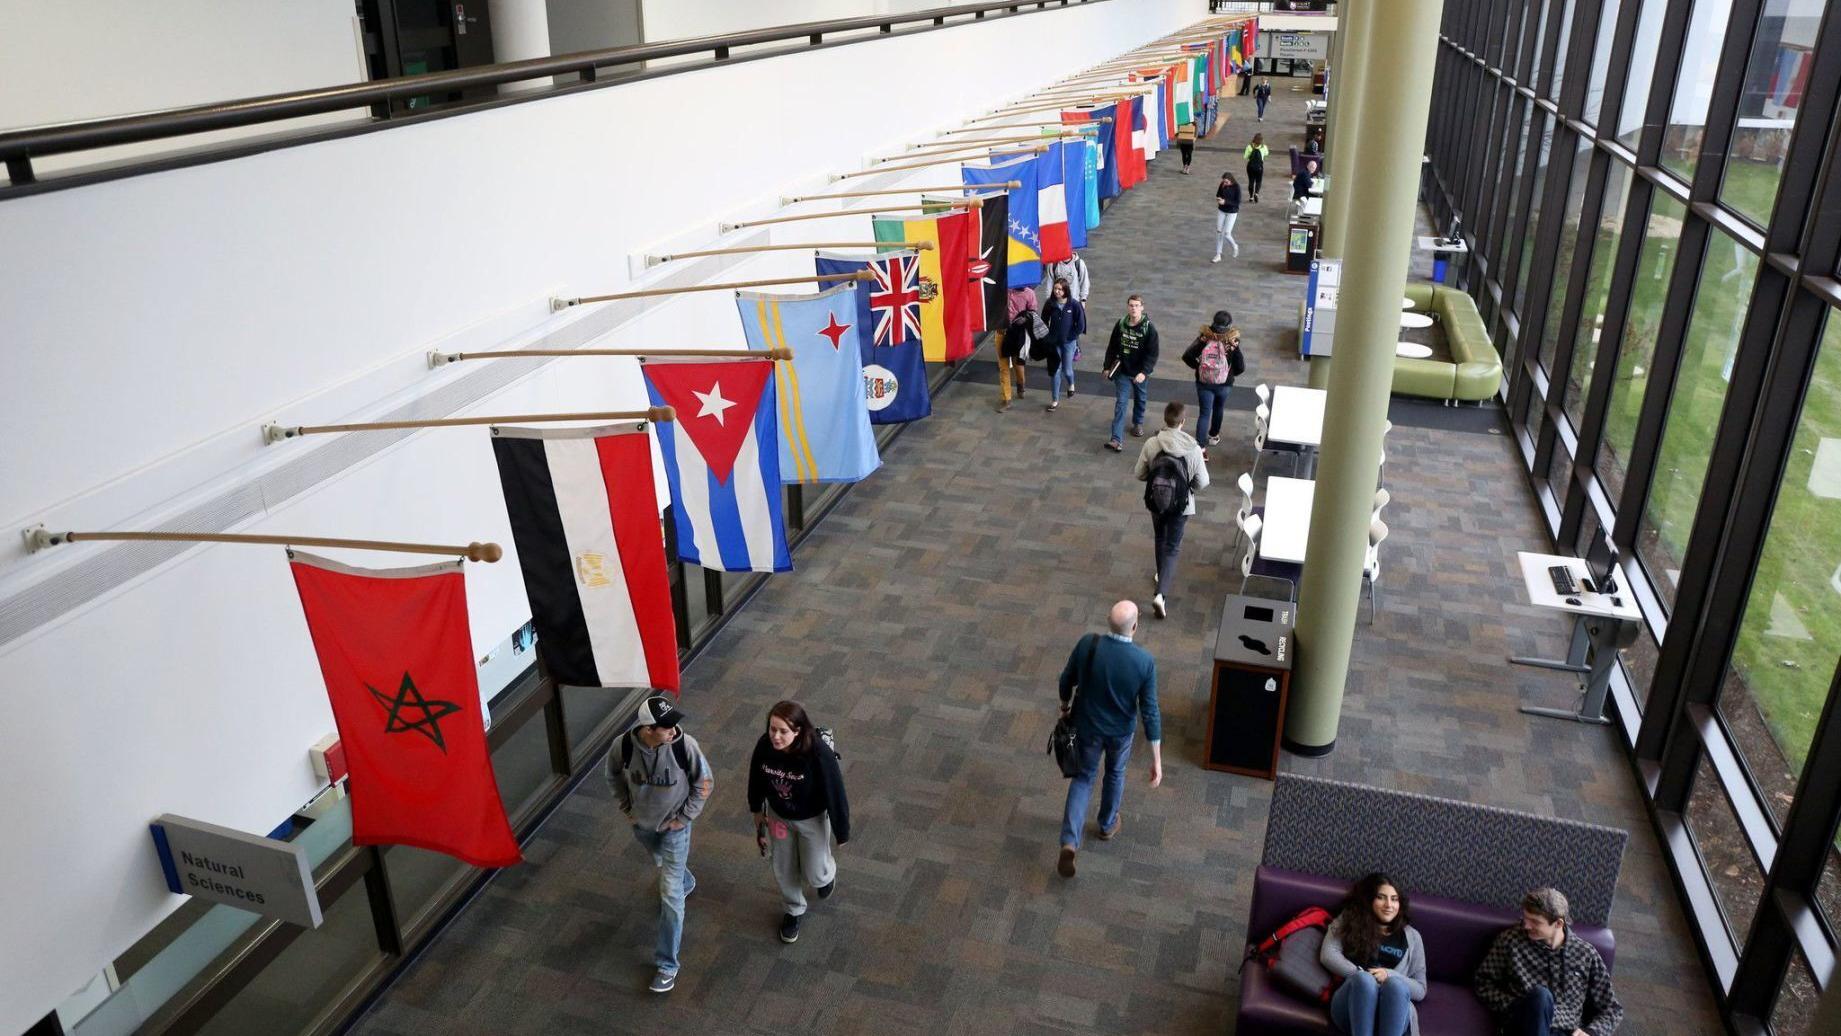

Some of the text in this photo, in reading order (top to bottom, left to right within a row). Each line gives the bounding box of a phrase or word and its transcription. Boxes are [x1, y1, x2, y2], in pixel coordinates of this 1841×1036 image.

[1276, 636, 1287, 662] RECYCLING
[181, 850, 245, 879] Natural
[188, 873, 266, 905] Sciences
